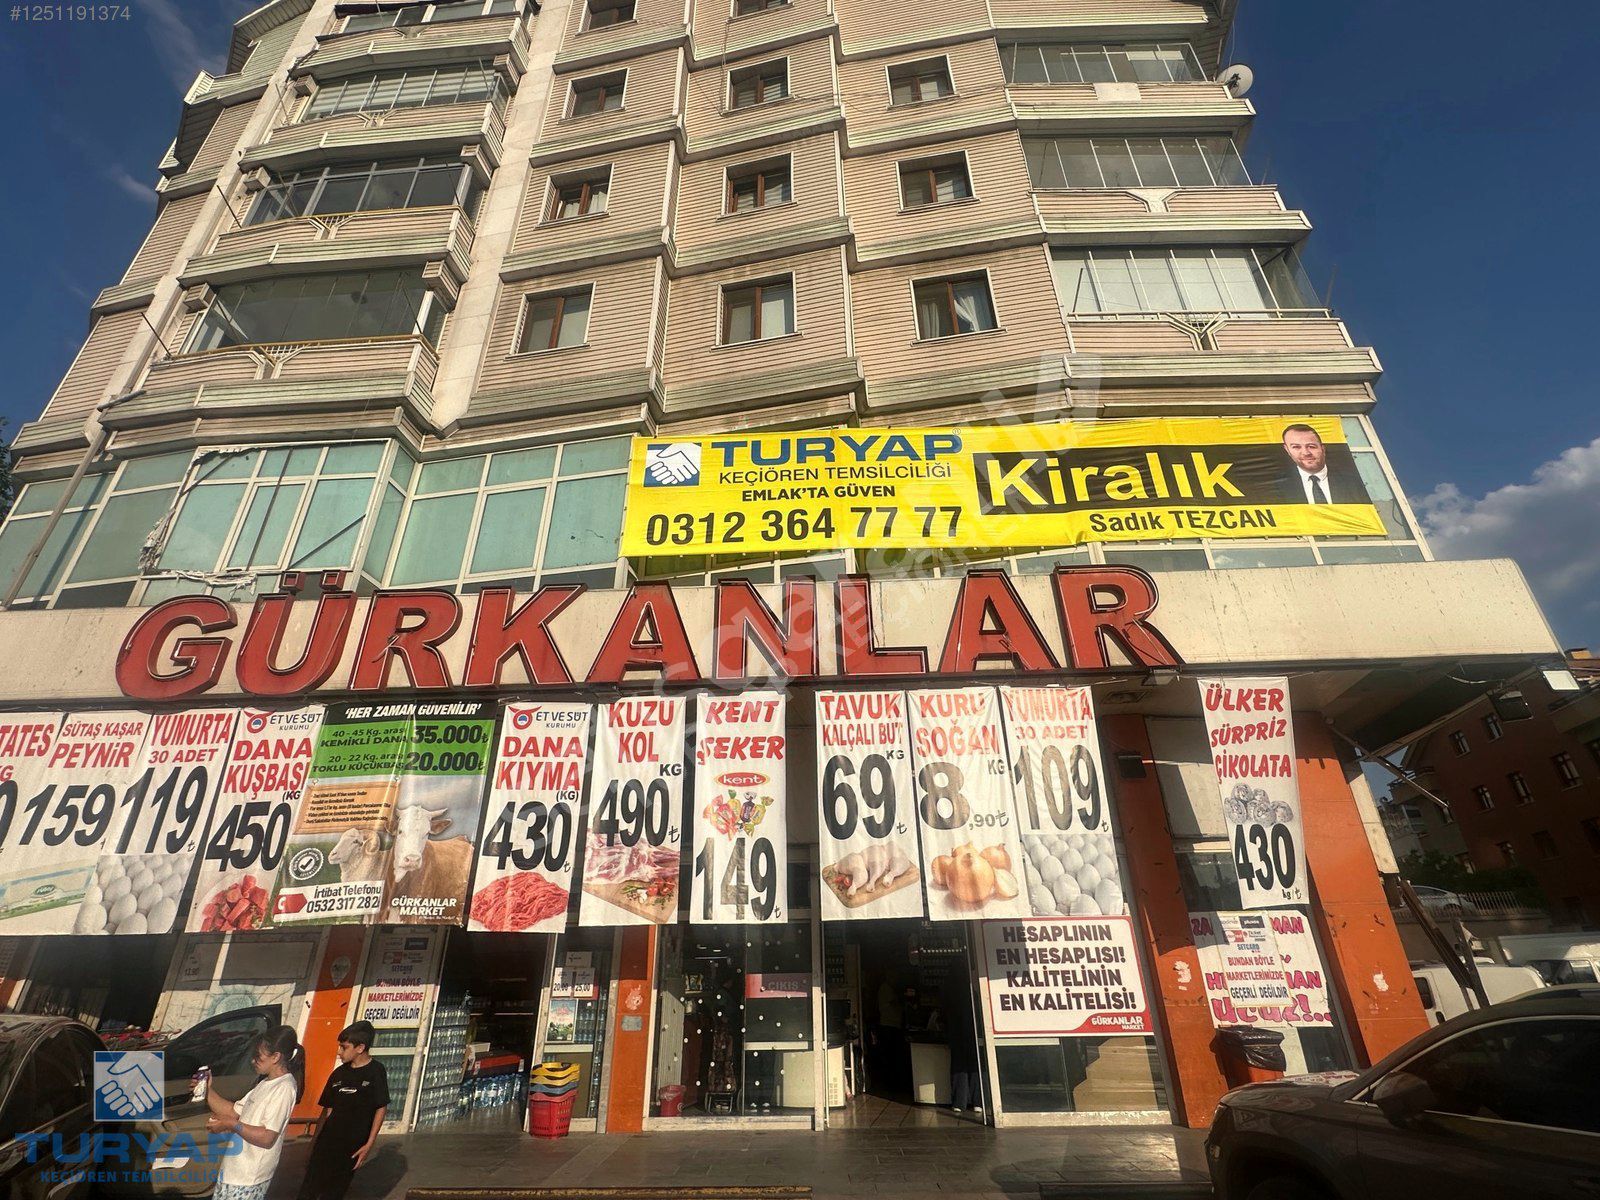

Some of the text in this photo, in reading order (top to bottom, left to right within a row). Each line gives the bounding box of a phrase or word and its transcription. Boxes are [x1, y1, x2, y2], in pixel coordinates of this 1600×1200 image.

[711, 434, 963, 467] TURYAP
[719, 461, 951, 486] KEÇİÖREN TEMSİLCİLİĞİ
[986, 452, 1246, 507] Kiralık
[742, 484, 895, 502] EMLAK'TA GÜVEN
[646, 506, 963, 546] 0312 364 77 77
[1090, 508, 1277, 533] Sadık TEZCAN
[115, 565, 1185, 701] GÜRKANLAR
[820, 693, 902, 720] TAVUK
[919, 693, 986, 718] KURU
[1002, 688, 1093, 722] YUMURTA
[1206, 683, 1284, 712] ÜLKER
[270, 713, 323, 725] ET VE SÜT
[373, 703, 416, 717] ZAMAN
[536, 711, 588, 722] ET VE SÜT
[608, 700, 675, 727] KUZU
[705, 700, 779, 724] KENT
[62, 720, 144, 740] SÜTAŞ KAŞAR
[150, 713, 233, 746] YUMURTA
[320, 736, 371, 747] KEMİKLİ
[332, 730, 345, 738] 40
[383, 727, 406, 735] aras
[822, 722, 903, 751] KALÇALI BUT
[916, 718, 1000, 757] SOĞAN
[1015, 725, 1088, 740] 30 ADET
[1211, 716, 1287, 748] SÜRPRİZ
[48, 741, 135, 768] PEYNİR
[148, 748, 219, 764] 30 ADET
[233, 738, 312, 761] DANA
[502, 736, 584, 758] DANA
[618, 731, 659, 763] KOL
[697, 735, 785, 765] ŞEKER
[886, 750, 905, 760] KG
[313, 764, 346, 773] TOKLU
[495, 761, 581, 791] KIYMA
[659, 763, 682, 776] KG
[987, 759, 1005, 775] KG
[1215, 749, 1292, 784] ÇİKOLATA
[723, 774, 764, 786] kent
[1014, 744, 1101, 830] 109
[556, 790, 579, 802] (KG)
[822, 754, 896, 840] 69
[19, 784, 115, 847] 159
[115, 766, 208, 854] 119
[593, 778, 670, 847] 490
[205, 801, 292, 872] 450
[482, 801, 572, 872] 430
[1234, 823, 1296, 891] 430
[314, 884, 381, 898] İrtibat Telefonu
[696, 837, 777, 921] 149
[306, 898, 335, 913] 0532
[336, 897, 355, 910] 317
[391, 896, 457, 907] GÜRKANLAR
[400, 906, 446, 916] MARKET
[1002, 925, 1112, 942] HESAPLININ
[996, 946, 1126, 965] EN HESAPLISI!
[1227, 955, 1254, 967] BUNDAN
[1254, 954, 1274, 966] BÖYLE
[1006, 965, 1123, 988] KALİTELİNİN
[1226, 969, 1285, 981] MARKETLERİMİZDE
[368, 991, 423, 1002] MARKETLERİMİZDE
[1000, 987, 1137, 1011] EN KALİTELİSİ!
[1230, 984, 1289, 1001] GEÇERLİ DEĞİLDİR
[365, 1004, 419, 1021] GEÇERLİ DEĞİLDİR
[1091, 1015, 1144, 1026] GÜRKANLAR
